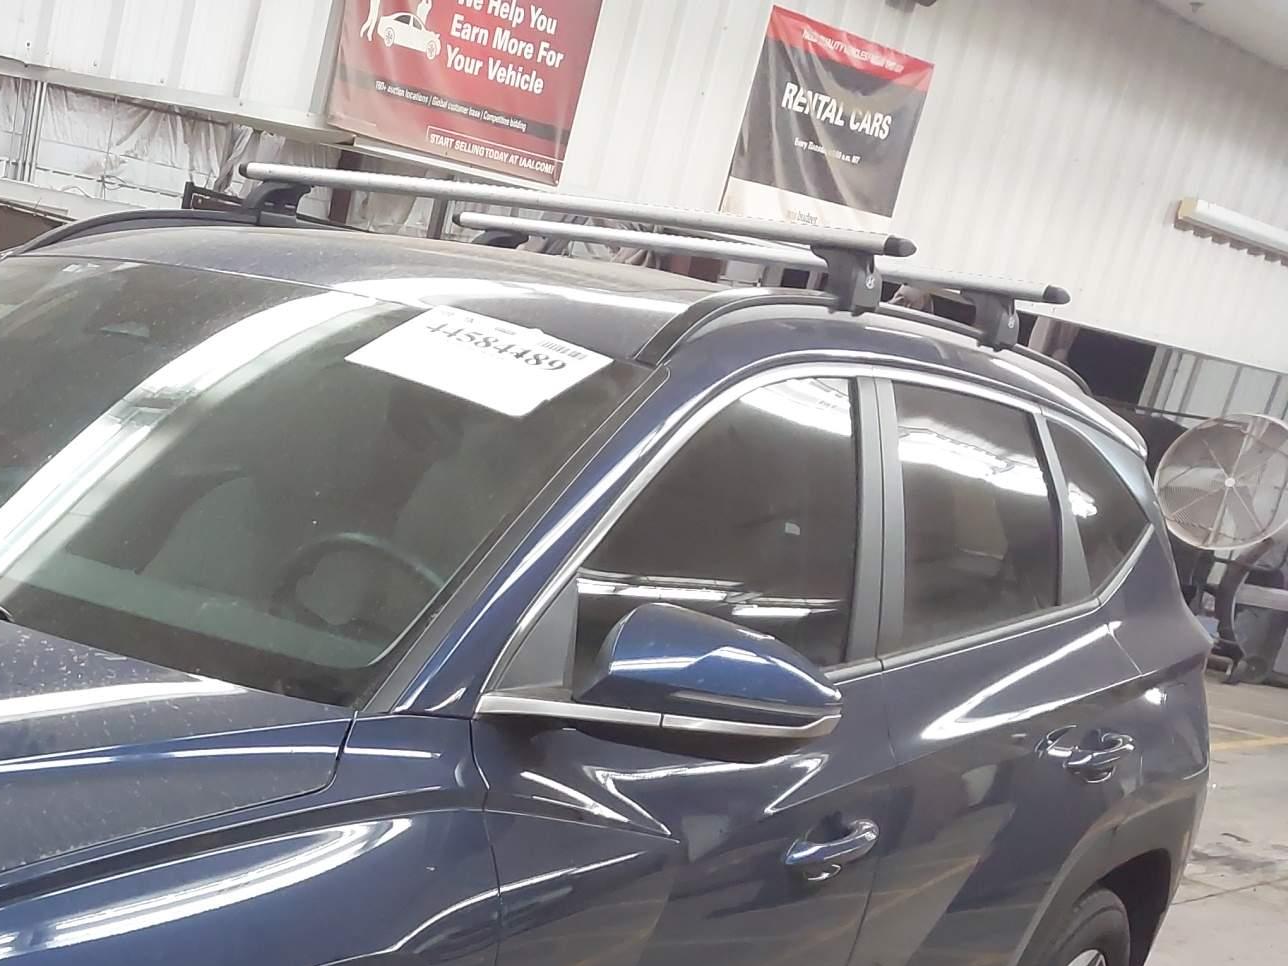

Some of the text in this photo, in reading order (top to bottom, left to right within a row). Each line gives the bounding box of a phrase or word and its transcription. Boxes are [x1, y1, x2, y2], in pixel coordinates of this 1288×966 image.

[450, 13, 565, 69] Earn More For
[487, 0, 525, 28] Help
[529, 4, 558, 35] You
[446, 44, 544, 95] Your Vehicle
[431, 96, 447, 109] Global
[781, 81, 892, 140] RENTAL CARS
[430, 133, 453, 150] START
[454, 137, 485, 157] SELLING
[485, 144, 509, 164] TODAY
[508, 154, 519, 166] AT
[425, 322, 567, 371] 44584489
